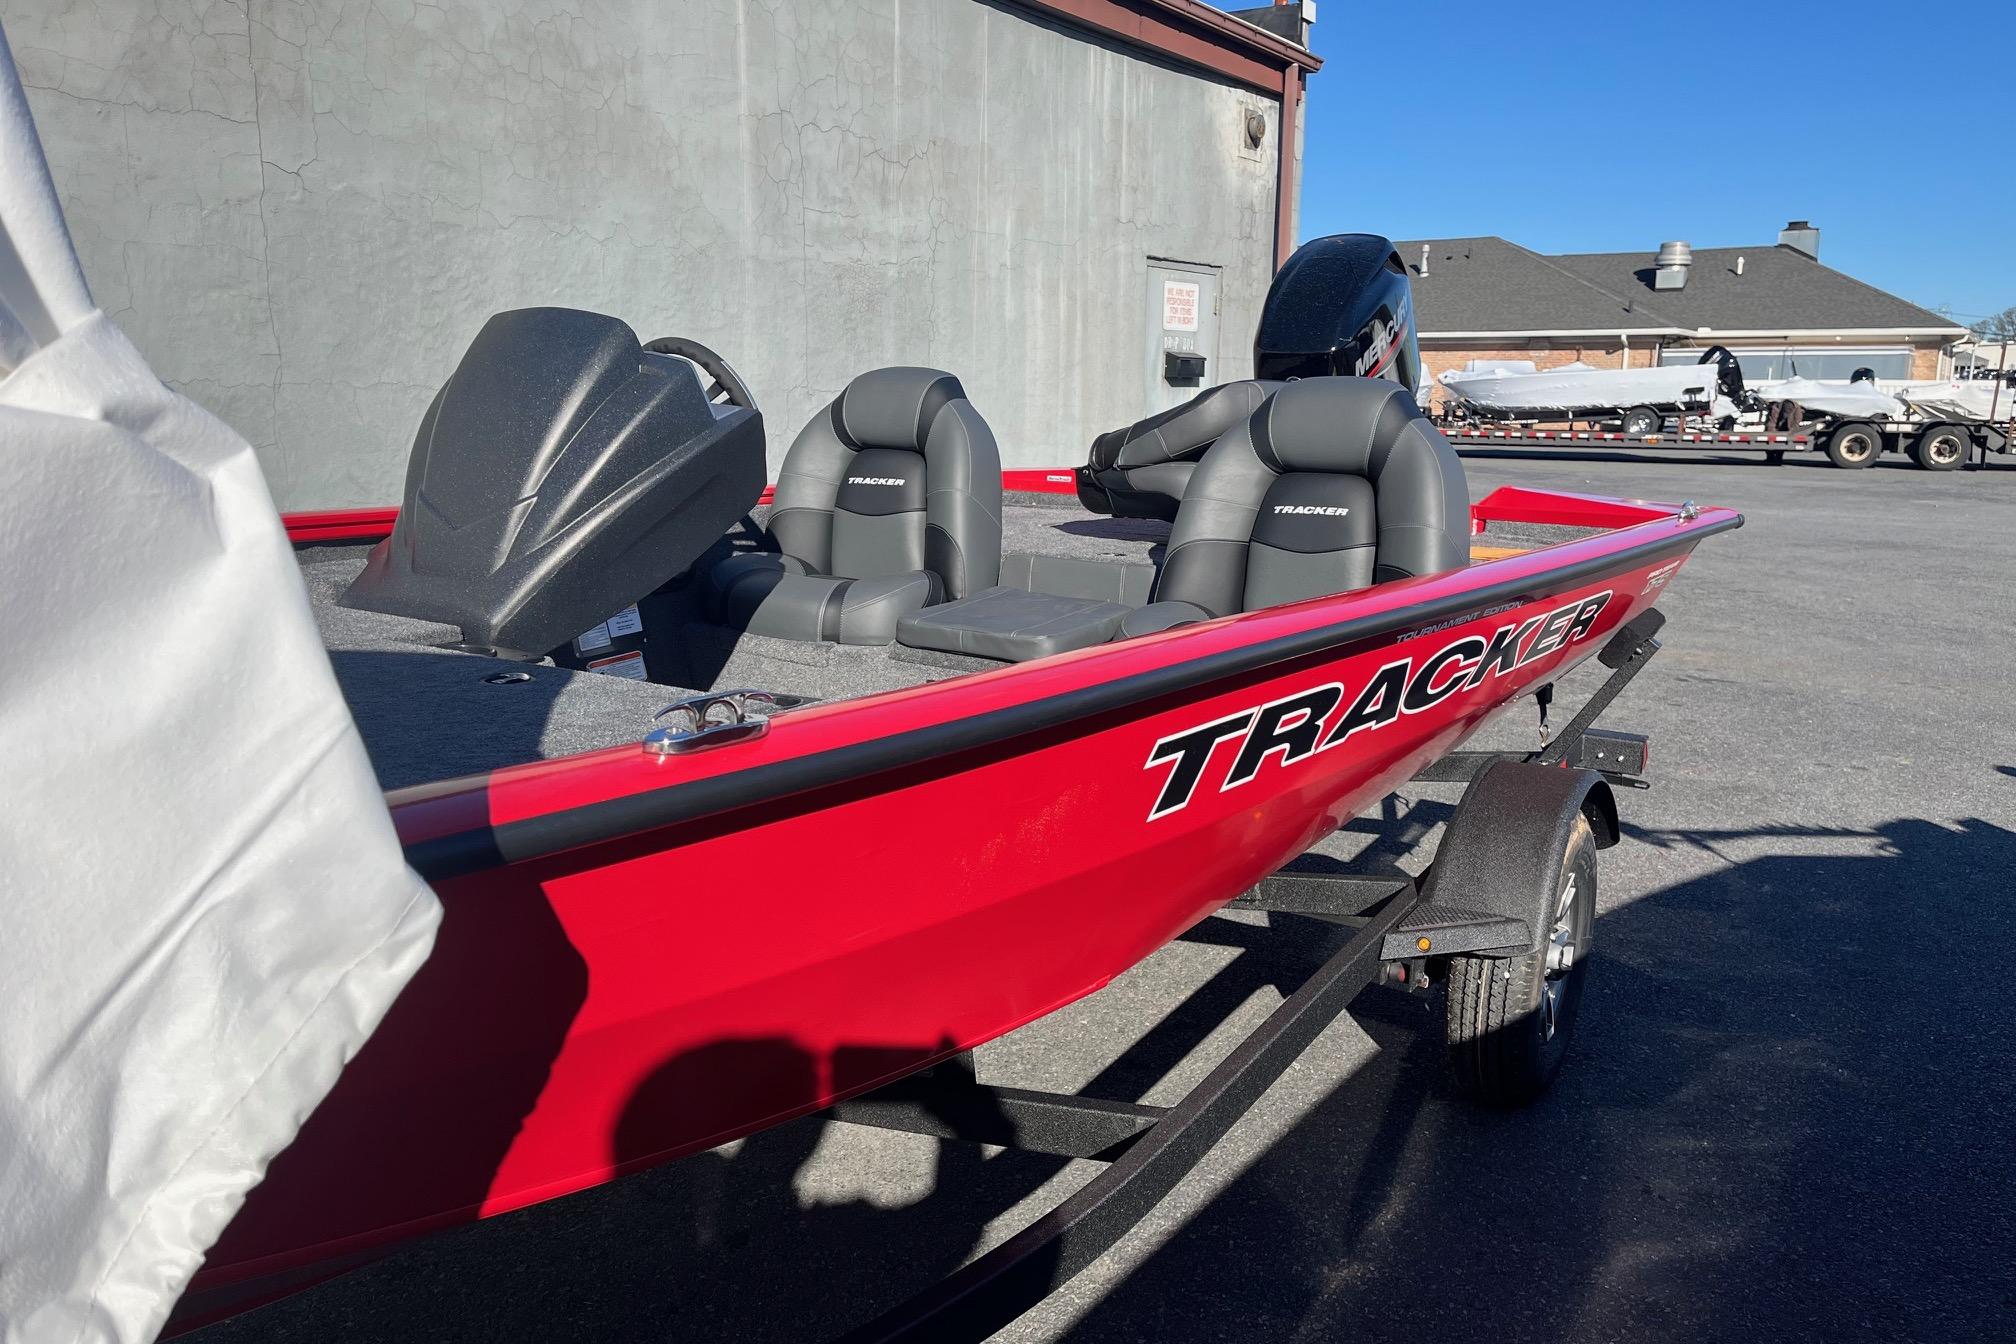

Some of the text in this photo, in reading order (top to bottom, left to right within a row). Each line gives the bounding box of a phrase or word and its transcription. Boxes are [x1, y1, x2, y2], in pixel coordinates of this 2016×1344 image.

[848, 477, 906, 486] TRACKER
[1273, 505, 1350, 516] TRACKER
[1396, 600, 1524, 644] TOURNAMENT EDITION
[1142, 590, 1613, 822] TRACKER
